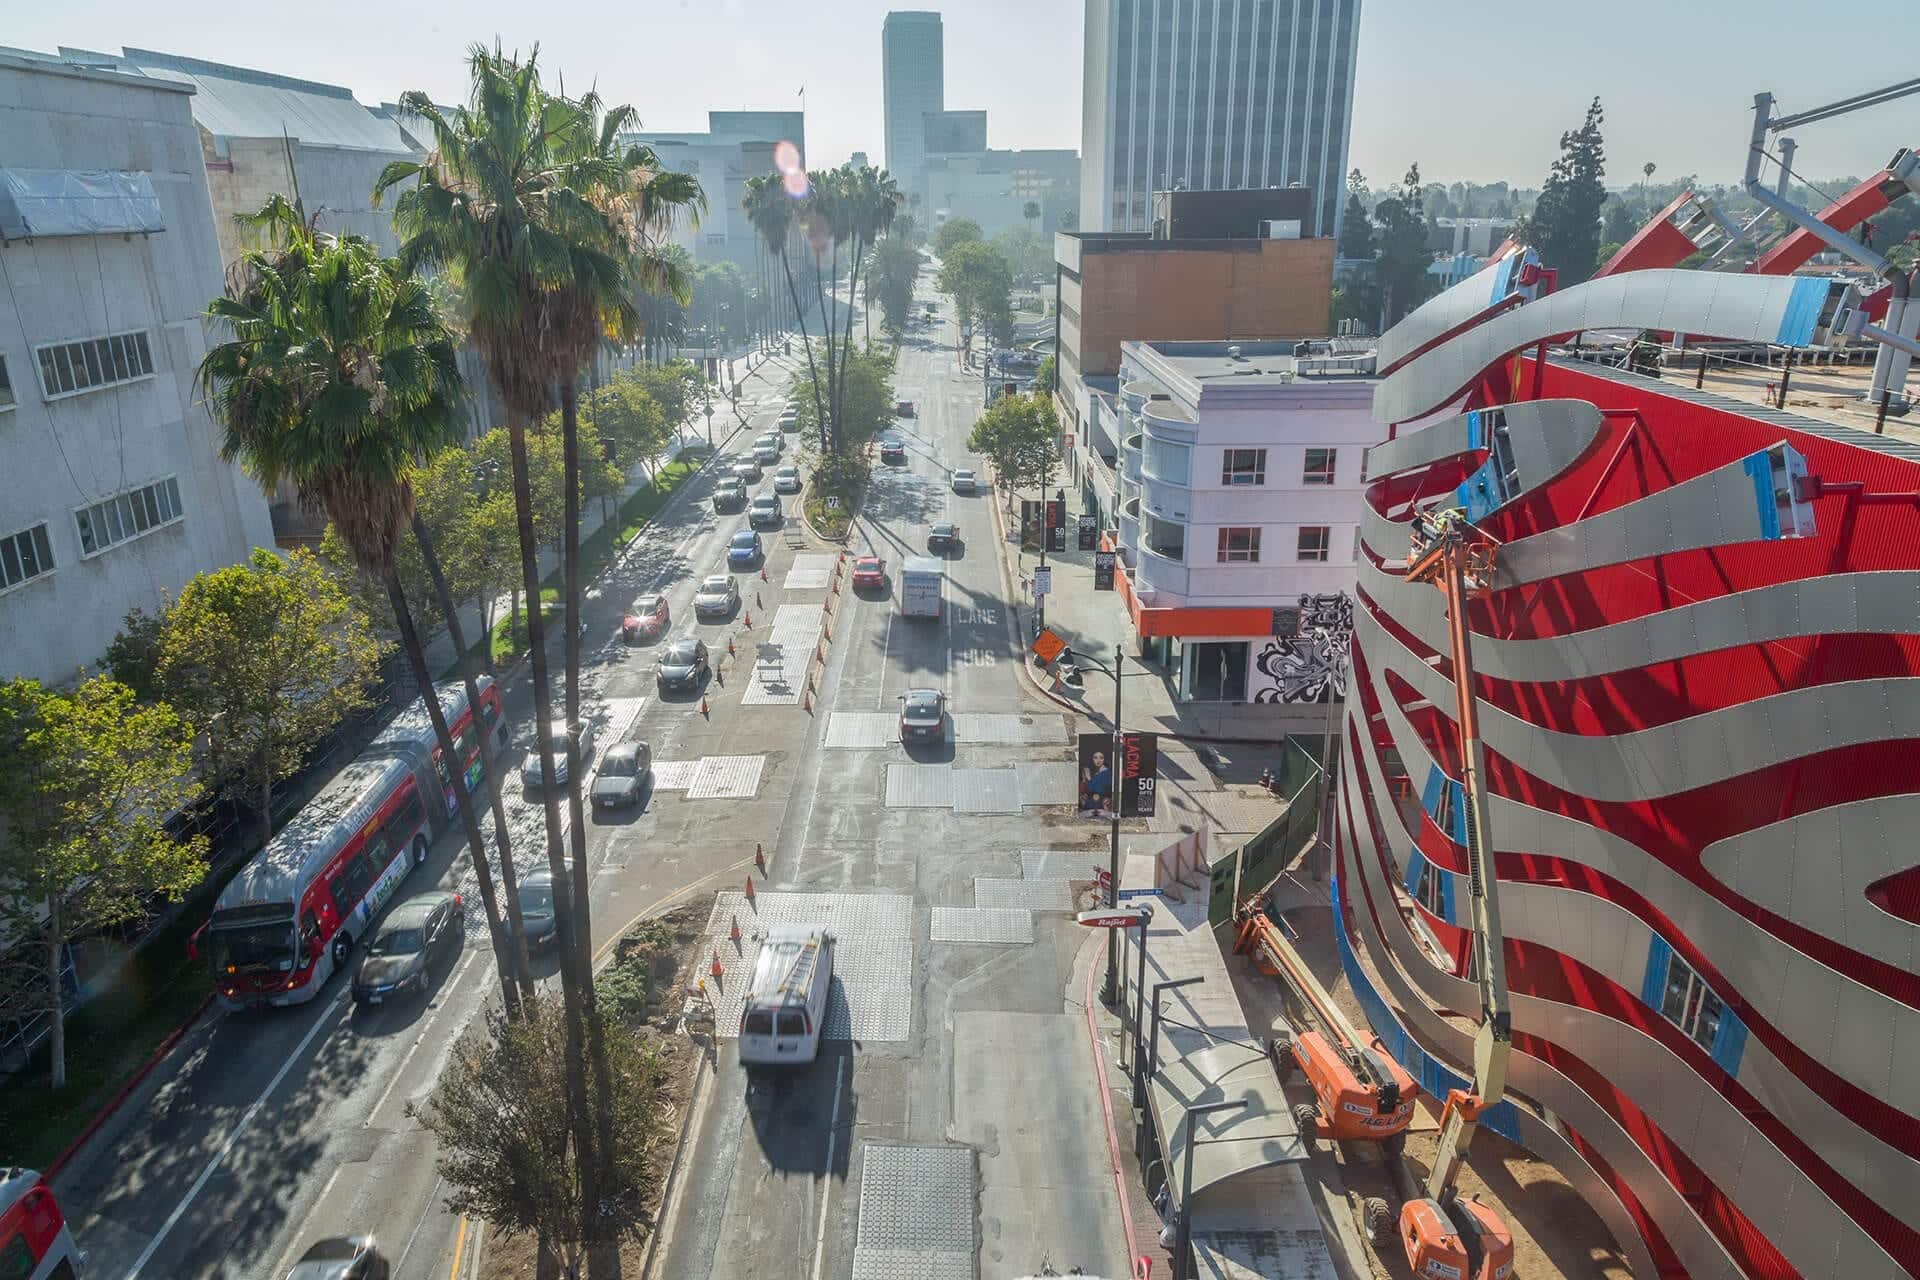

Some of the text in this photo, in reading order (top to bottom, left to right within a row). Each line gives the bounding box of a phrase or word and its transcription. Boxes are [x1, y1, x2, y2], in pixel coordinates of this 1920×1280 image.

[1055, 527, 1065, 536] 50
[958, 608, 997, 624] LANE
[963, 649, 996, 667] BUS
[1125, 736, 1140, 778] LACMA
[1138, 777, 1154, 790] 50
[1098, 919, 1126, 927] Rapid
